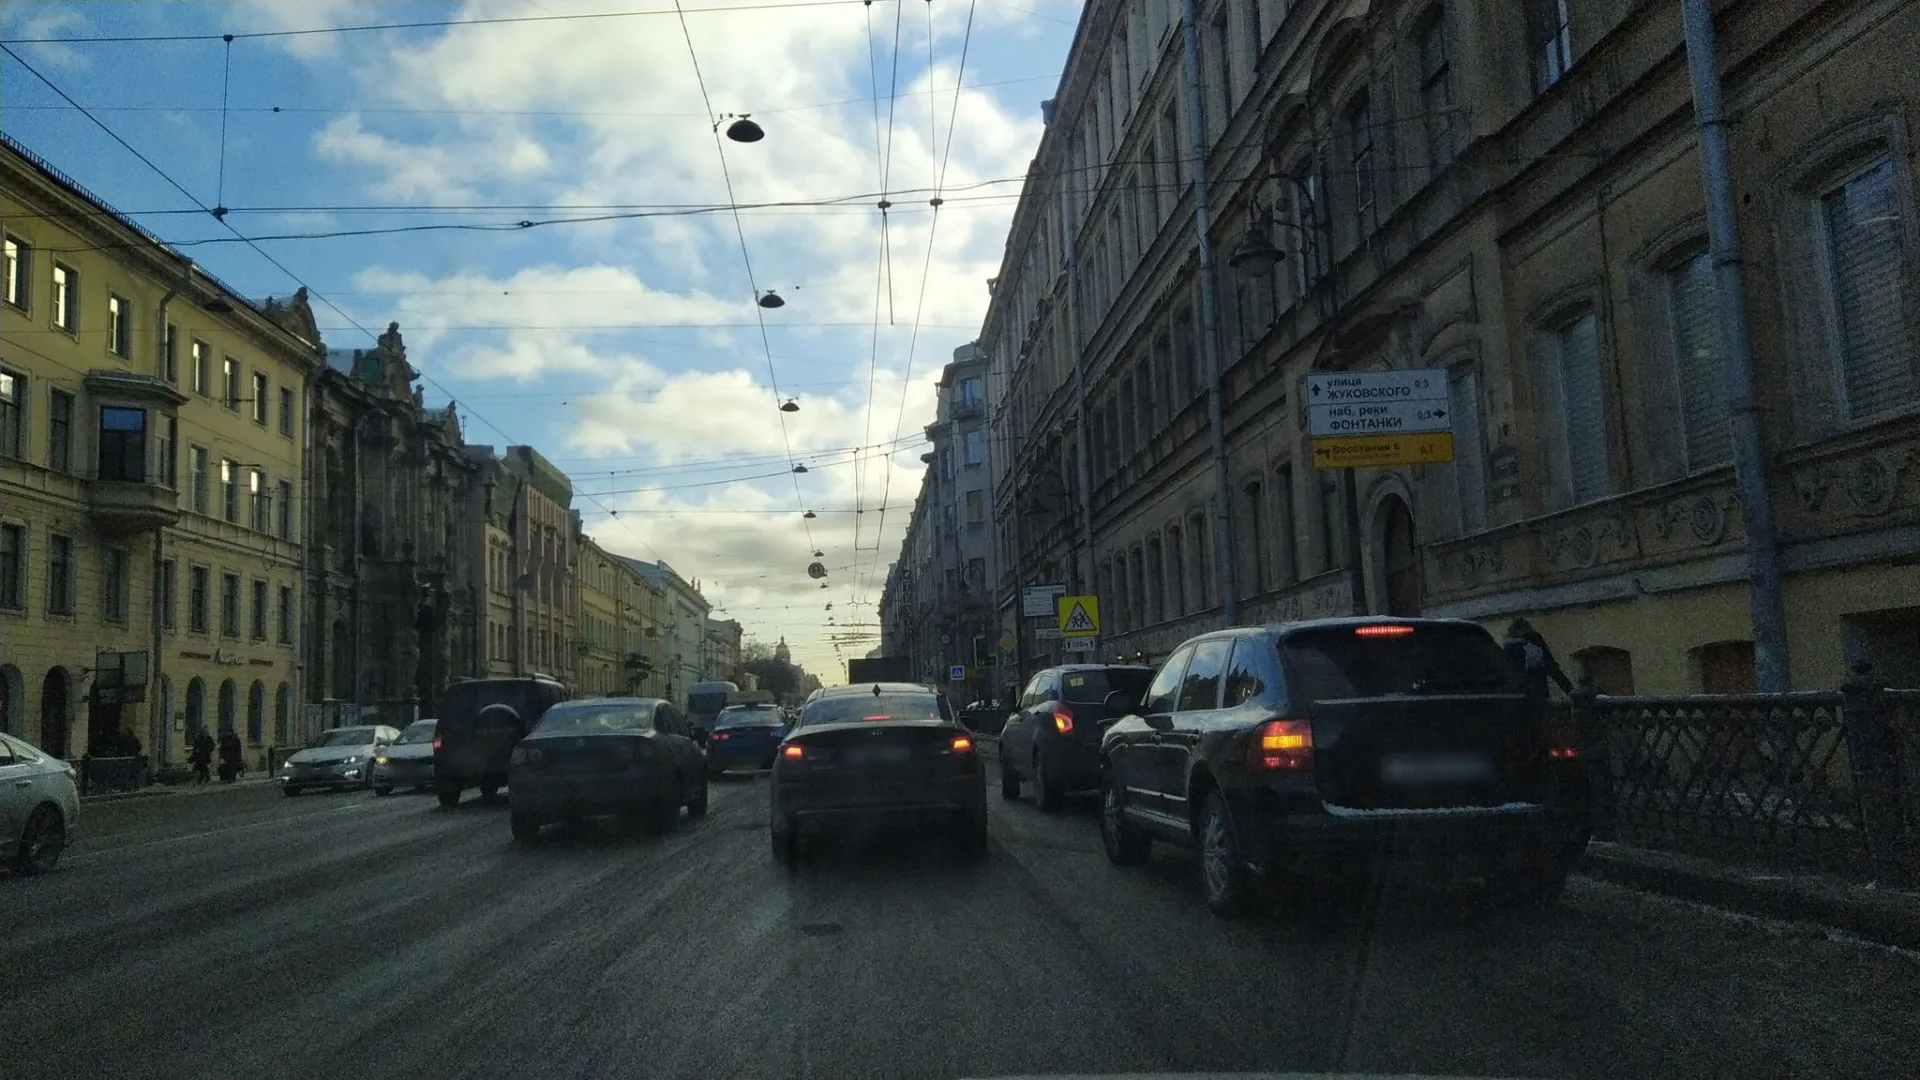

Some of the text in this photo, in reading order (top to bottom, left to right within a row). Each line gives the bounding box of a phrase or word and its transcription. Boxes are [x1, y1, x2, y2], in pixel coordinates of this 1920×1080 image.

[1327, 378, 1362, 388] улица
[1327, 386, 1411, 399] ЖУКОВСКОГО
[1329, 406, 1355, 416] наб.
[1359, 405, 1387, 416] реки
[1330, 417, 1402, 430] ФОНТАНКИ
